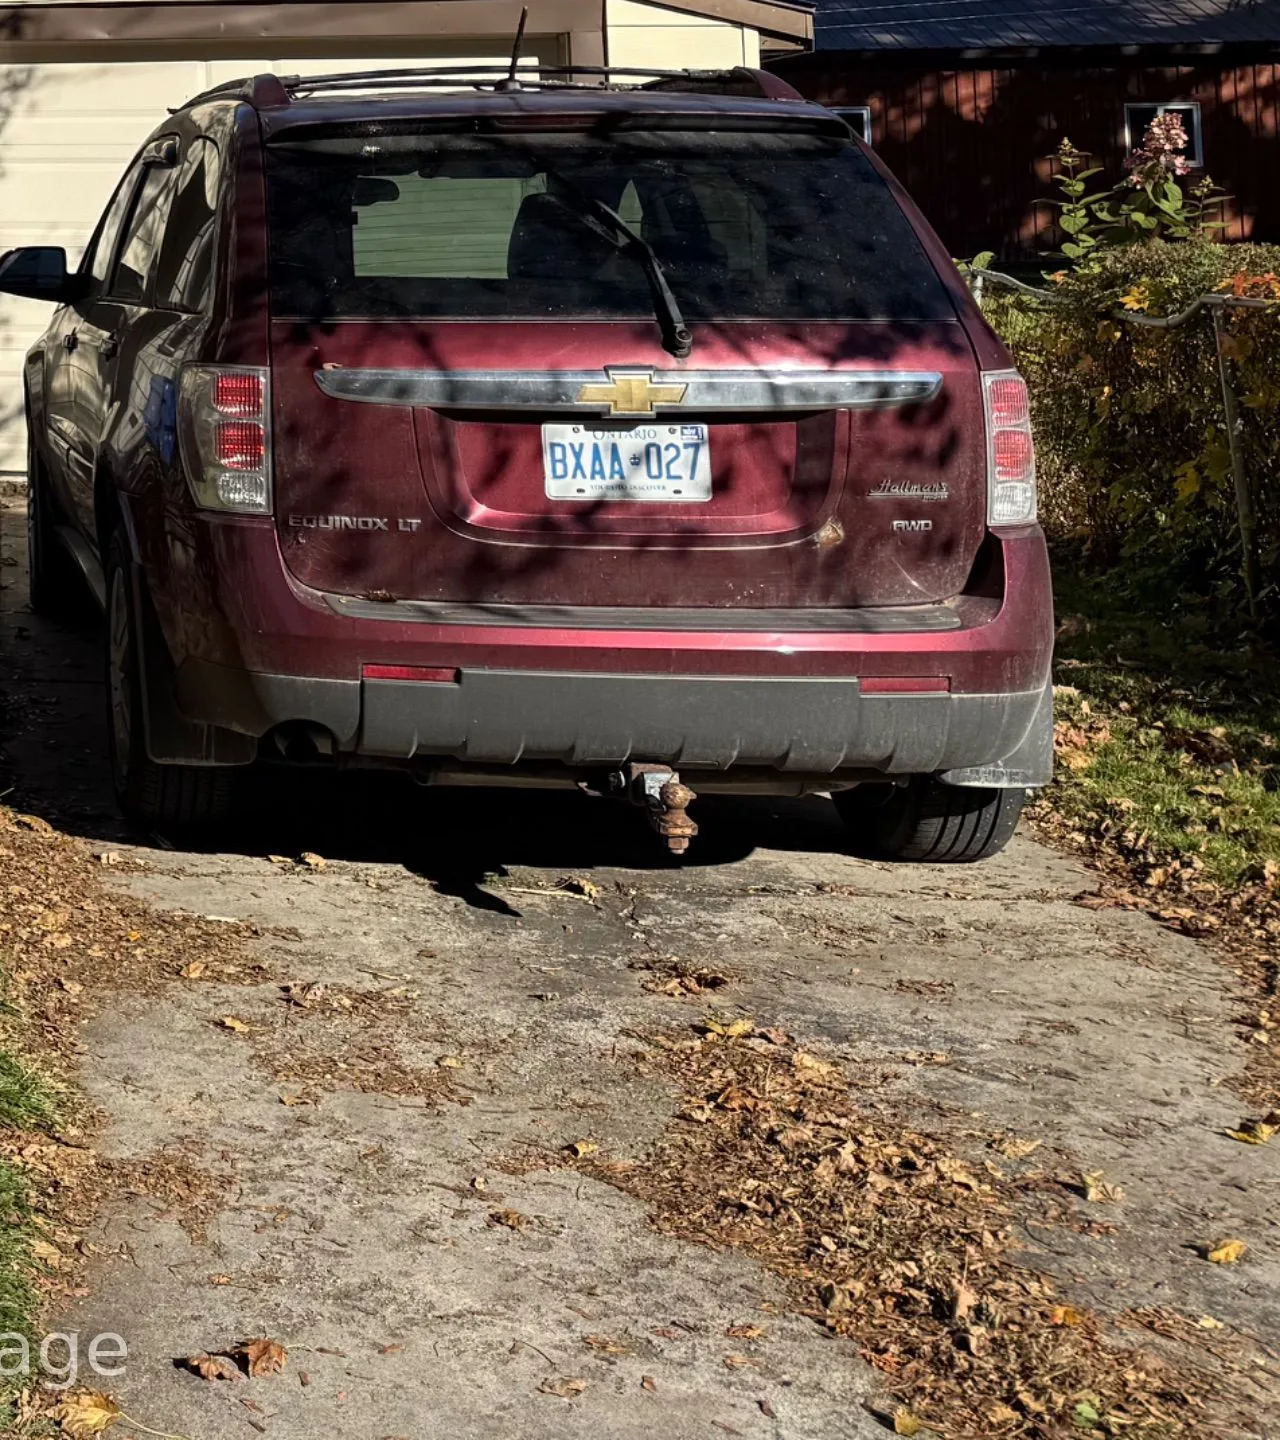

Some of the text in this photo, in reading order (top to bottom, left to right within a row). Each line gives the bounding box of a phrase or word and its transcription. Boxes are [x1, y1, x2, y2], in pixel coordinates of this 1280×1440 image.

[549, 442, 701, 480] BXAA 027
[289, 514, 422, 532] EQUINOX LT
[892, 520, 932, 531] AWD
